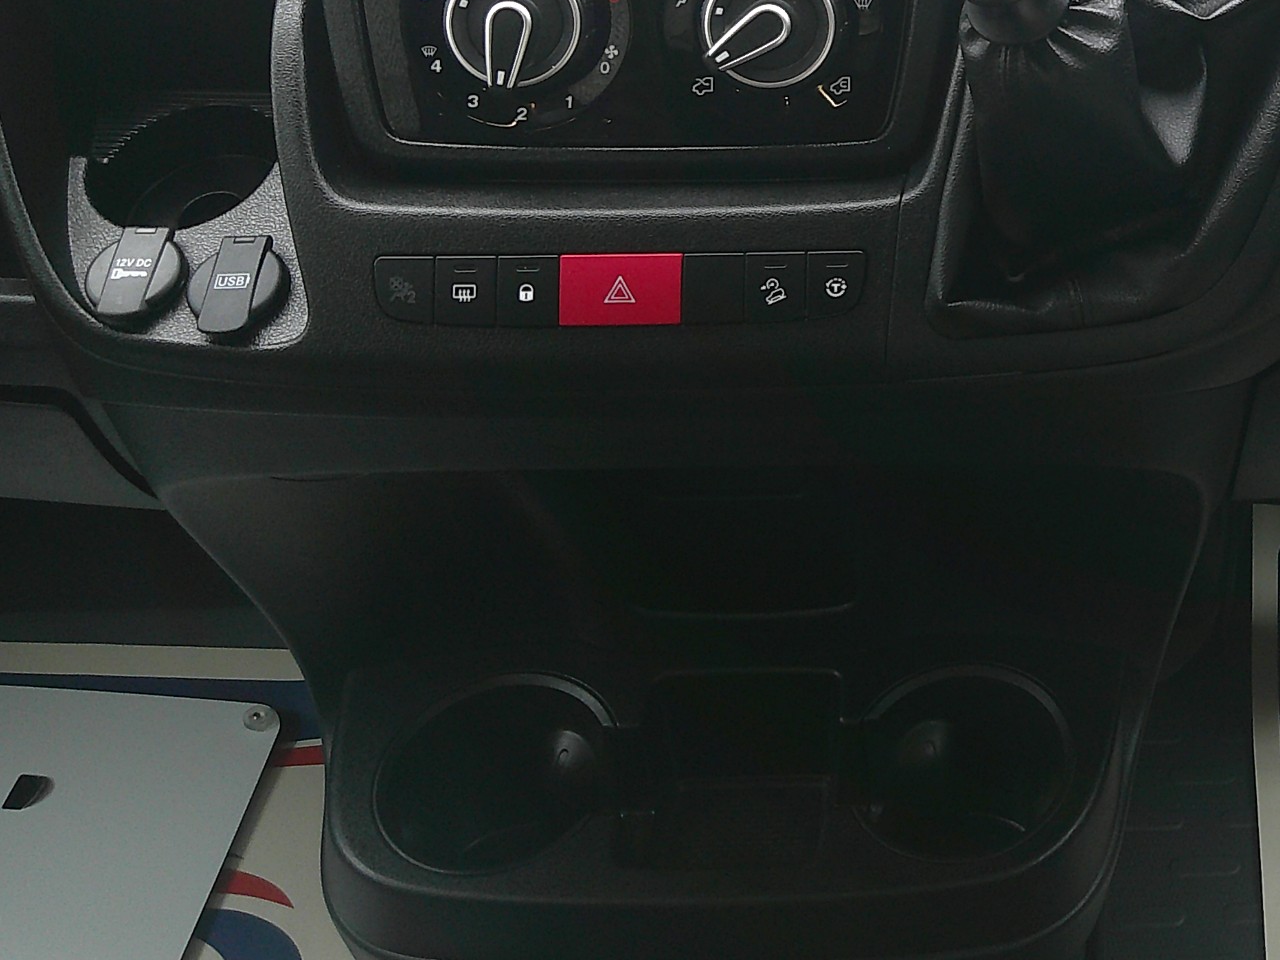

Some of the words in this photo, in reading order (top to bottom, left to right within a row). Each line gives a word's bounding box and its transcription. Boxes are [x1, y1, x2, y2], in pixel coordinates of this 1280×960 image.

[430, 59, 443, 73] 4
[600, 61, 611, 74] 0
[467, 94, 479, 108] 3
[565, 95, 573, 109] 1
[515, 107, 528, 121] 2
[116, 258, 135, 267] 12V
[135, 258, 153, 267] DC
[217, 276, 245, 287] USB
